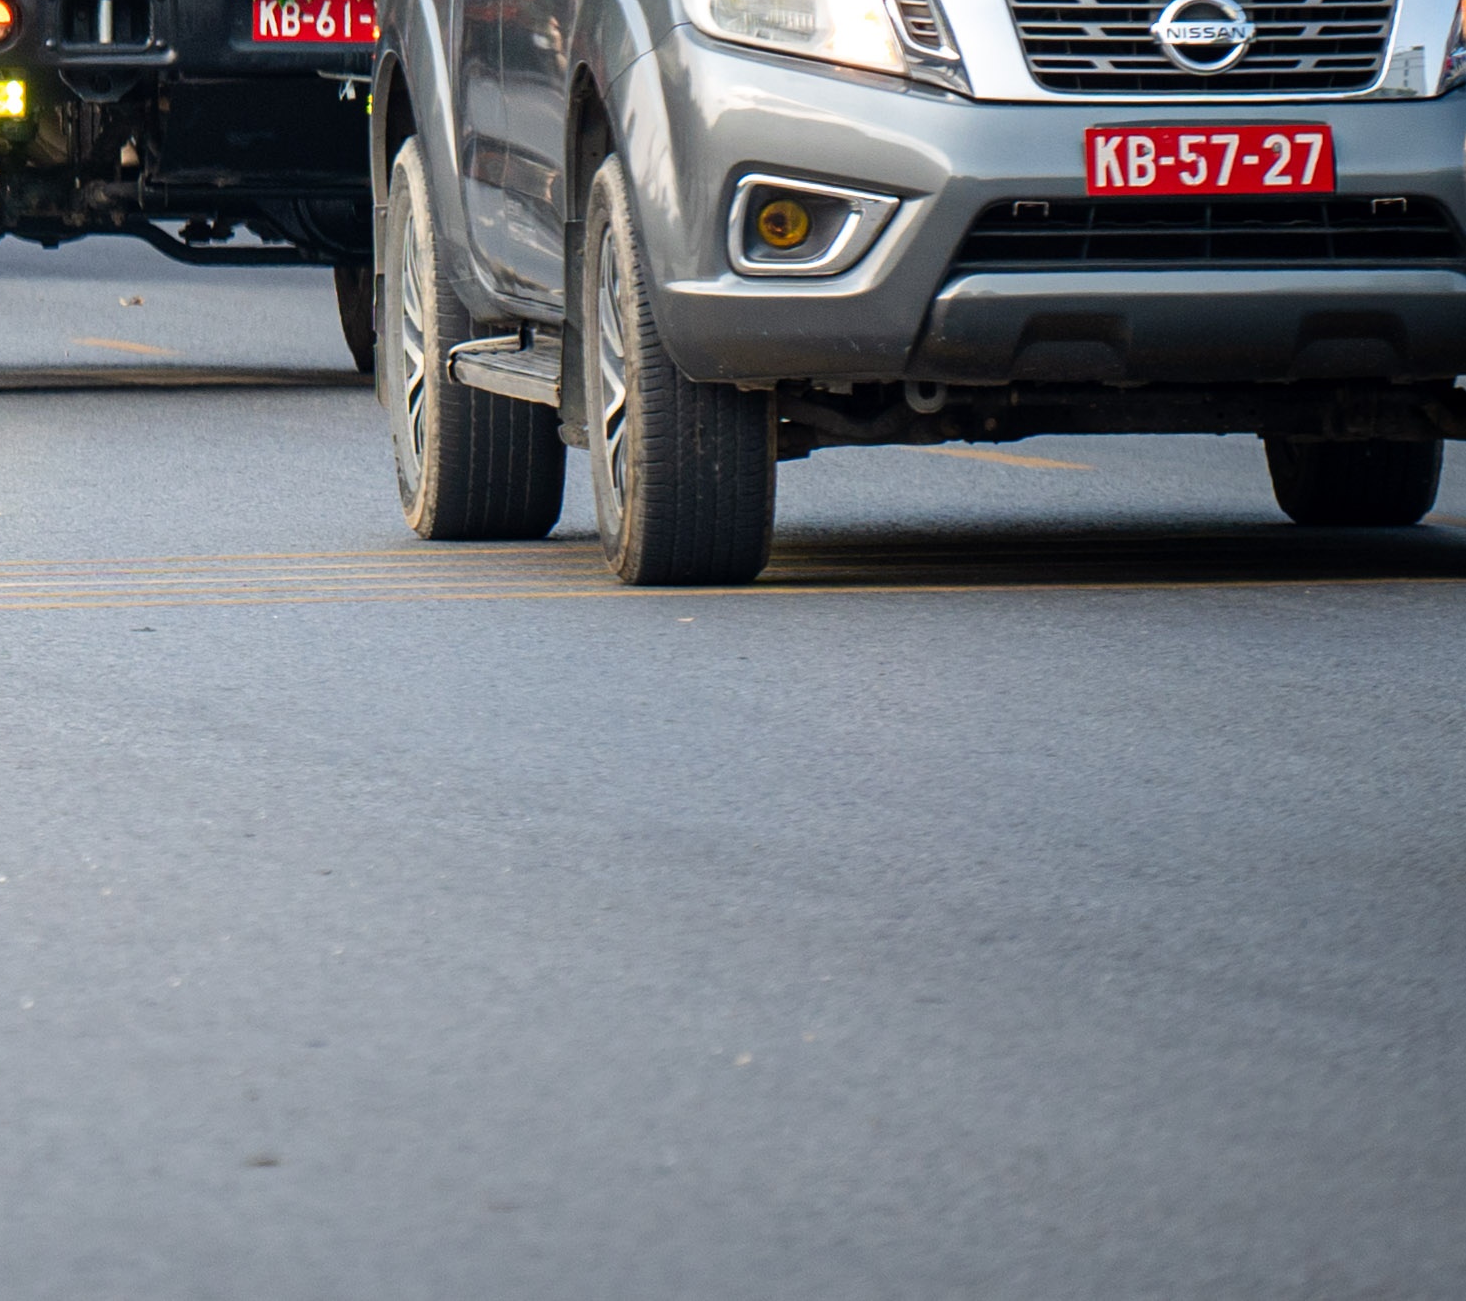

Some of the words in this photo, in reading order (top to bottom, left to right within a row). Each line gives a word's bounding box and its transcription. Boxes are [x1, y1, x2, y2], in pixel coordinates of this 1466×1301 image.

[259, 0, 378, 38] KB-61-
[1166, 25, 1246, 40] NISSAN
[1094, 133, 1324, 188] KB-57-27
